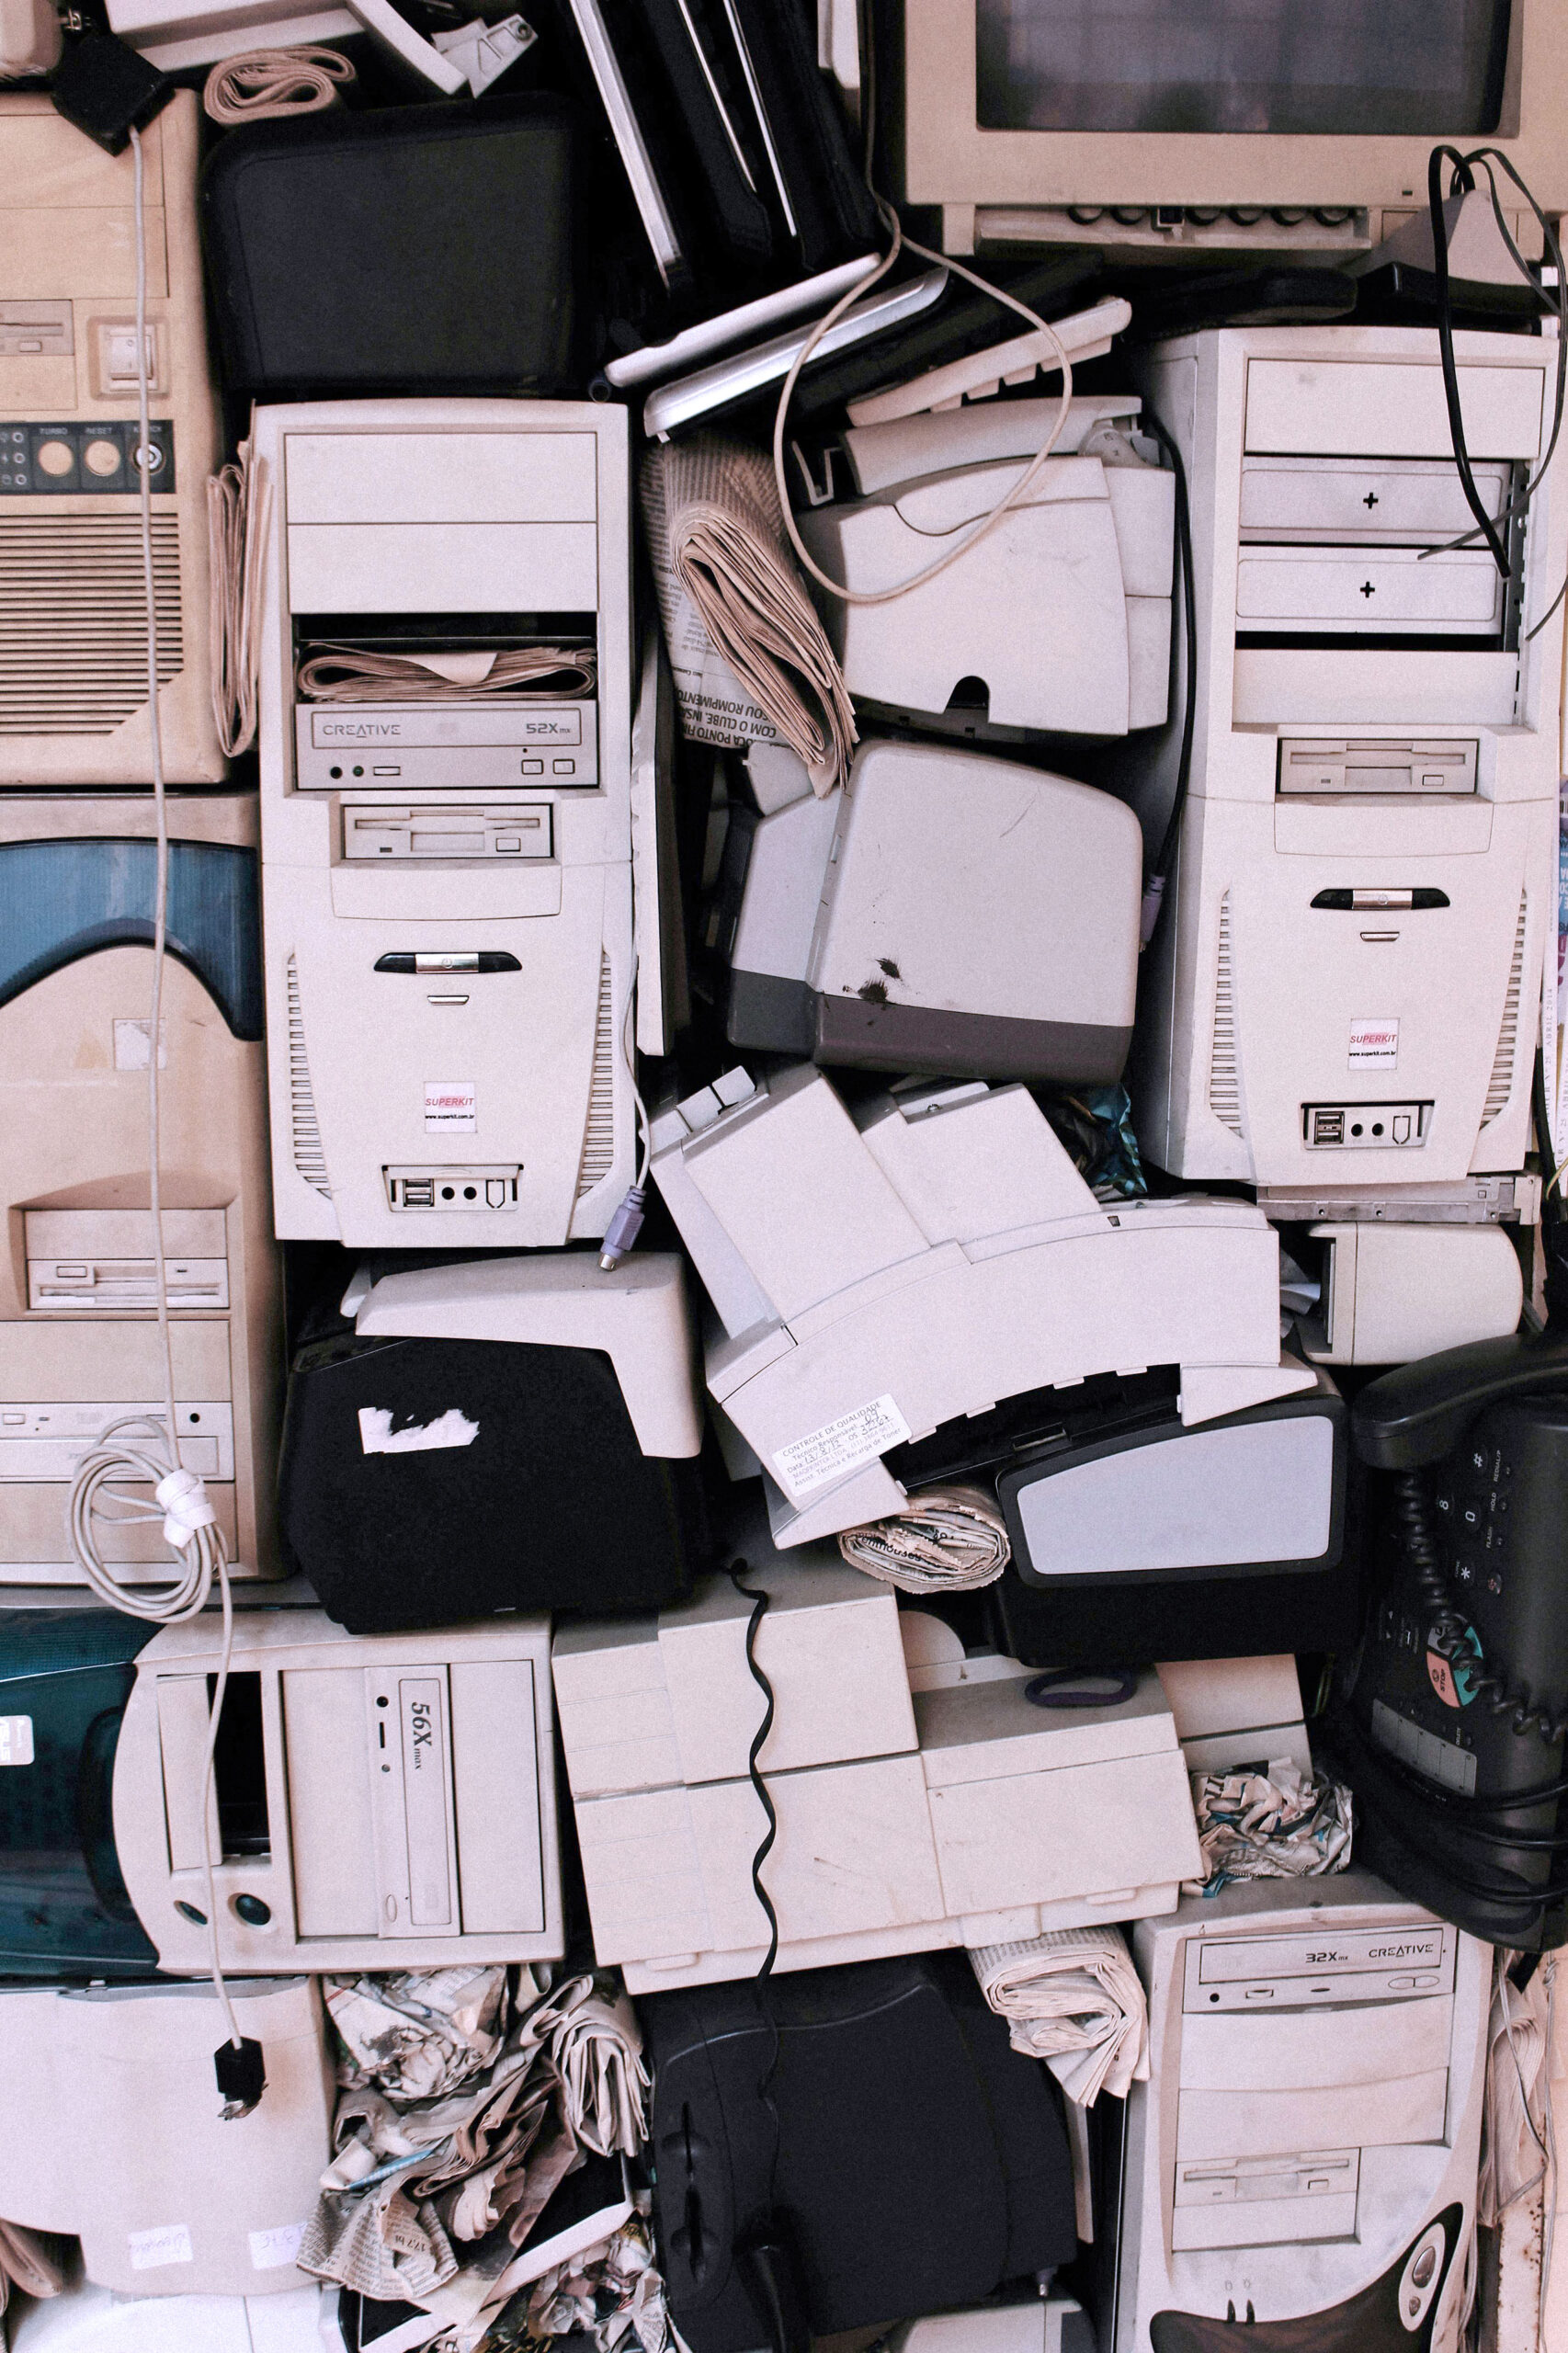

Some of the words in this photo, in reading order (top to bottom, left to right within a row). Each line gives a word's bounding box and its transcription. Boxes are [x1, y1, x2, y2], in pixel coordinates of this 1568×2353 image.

[85, 426, 112, 435] RESET
[677, 689, 744, 715] ROMPIMENTO
[705, 712, 737, 730] CLUBE.
[739, 721, 748, 732] O
[323, 723, 402, 738] CREATIVE
[699, 727, 731, 745] PONTO
[749, 725, 777, 739] COM
[1350, 1034, 1397, 1043] SUPERKIT
[425, 1097, 474, 1107] SUPERKIT
[782, 1433, 824, 1458] CONTROLE
[825, 1426, 835, 1435] DE
[836, 1400, 881, 1428] QUALIDADE
[1439, 1499, 1449, 1510] 8
[1369, 1943, 1434, 1959] CREATIVE
